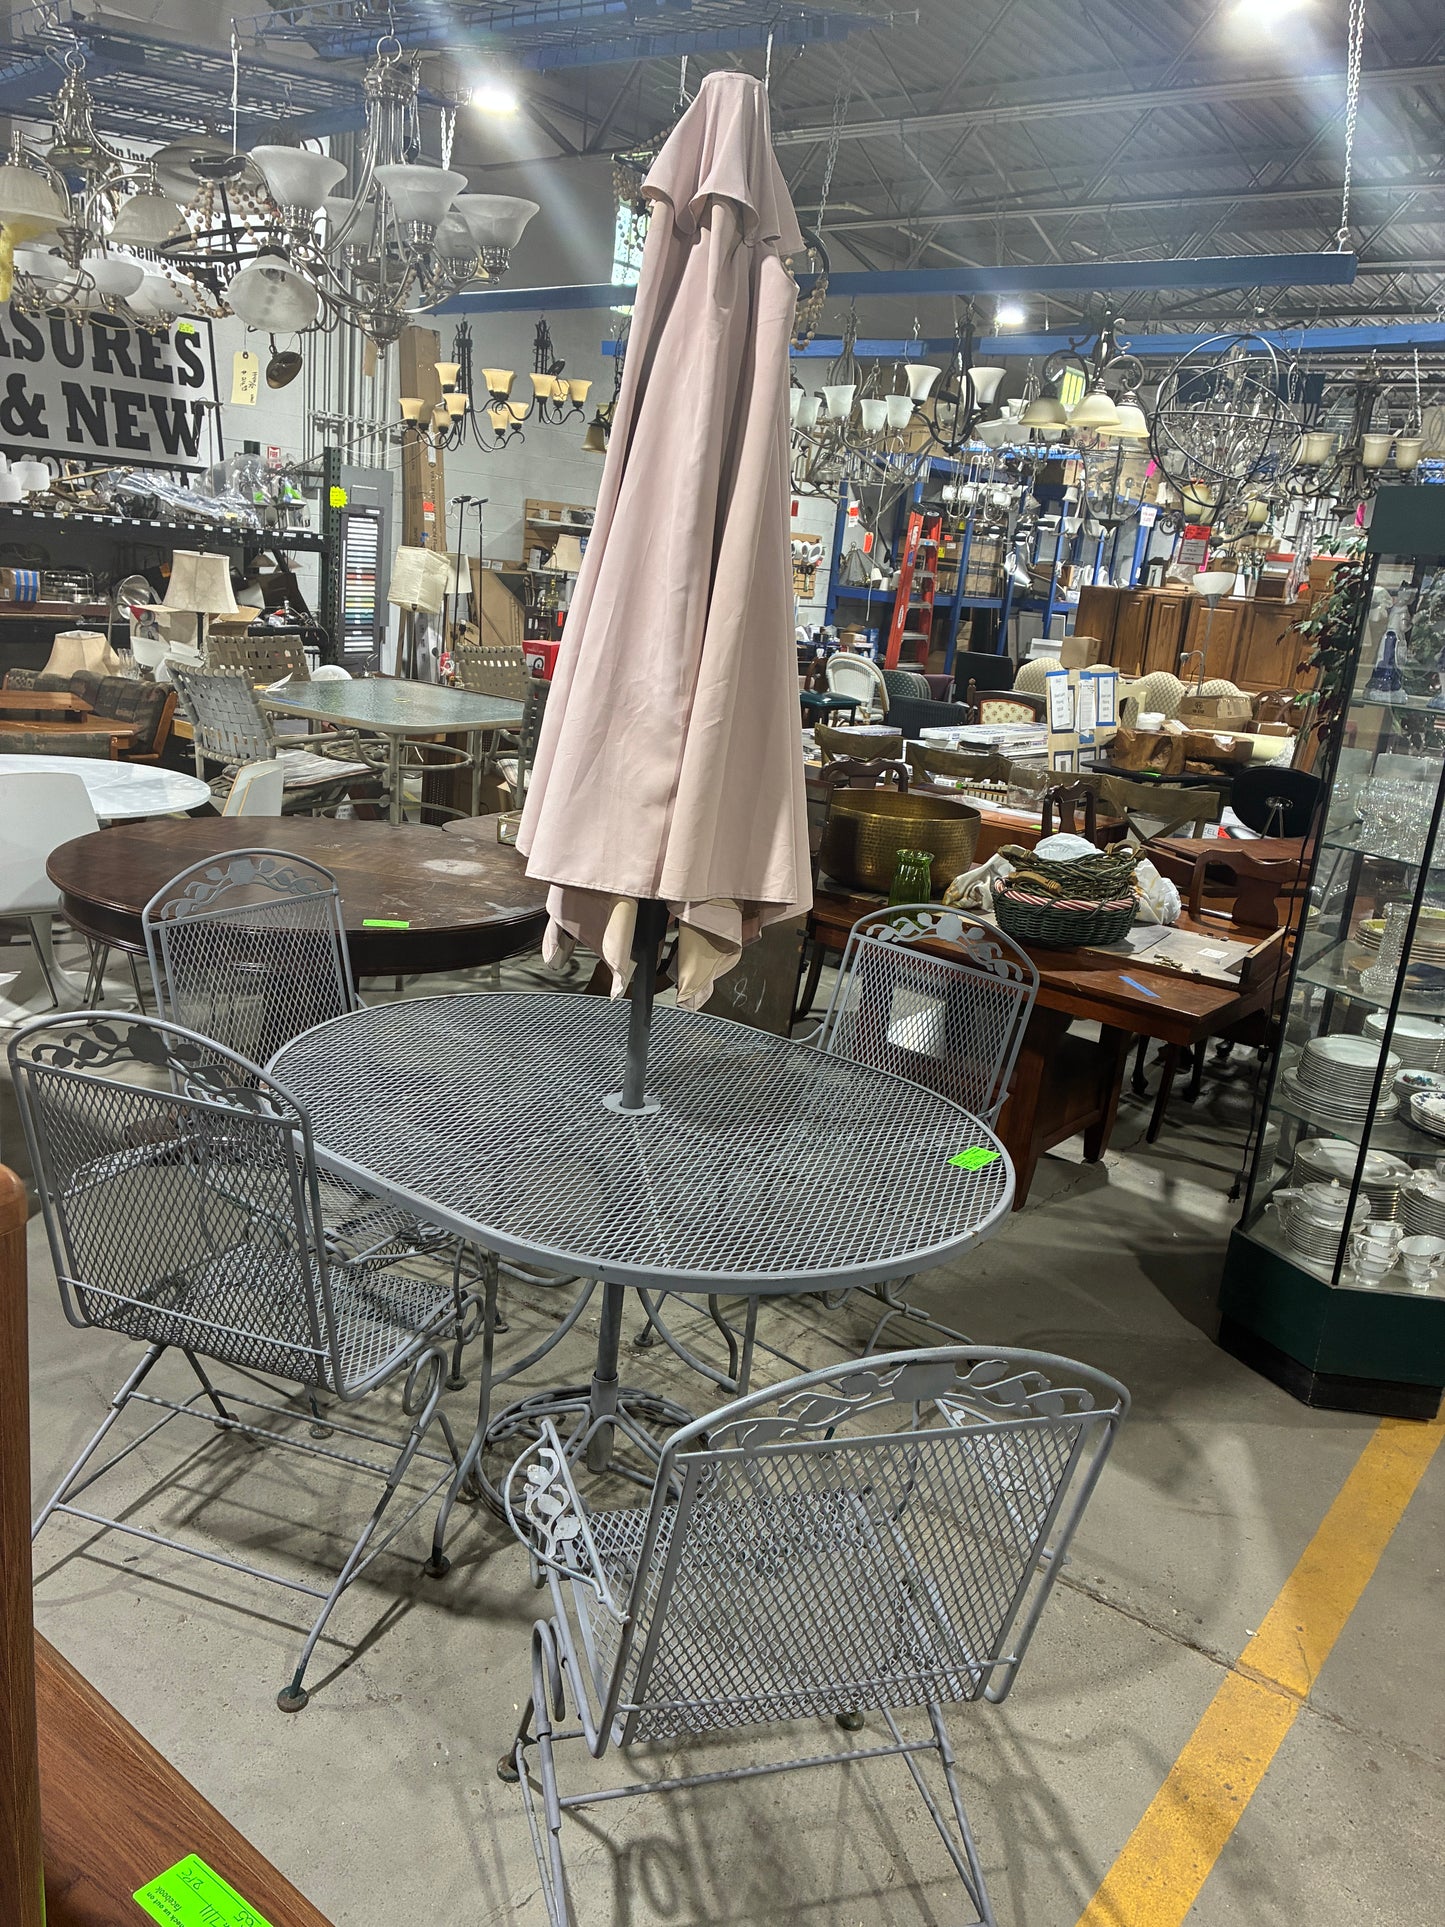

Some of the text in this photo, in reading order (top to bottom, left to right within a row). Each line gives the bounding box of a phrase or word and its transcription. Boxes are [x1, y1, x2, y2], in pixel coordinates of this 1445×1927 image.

[0, 300, 206, 389] SURES
[1, 372, 50, 440] &
[60, 380, 205, 458] NEW
[145, 1891, 185, 1927] heck us out on
[154, 1885, 183, 1913] facebook
